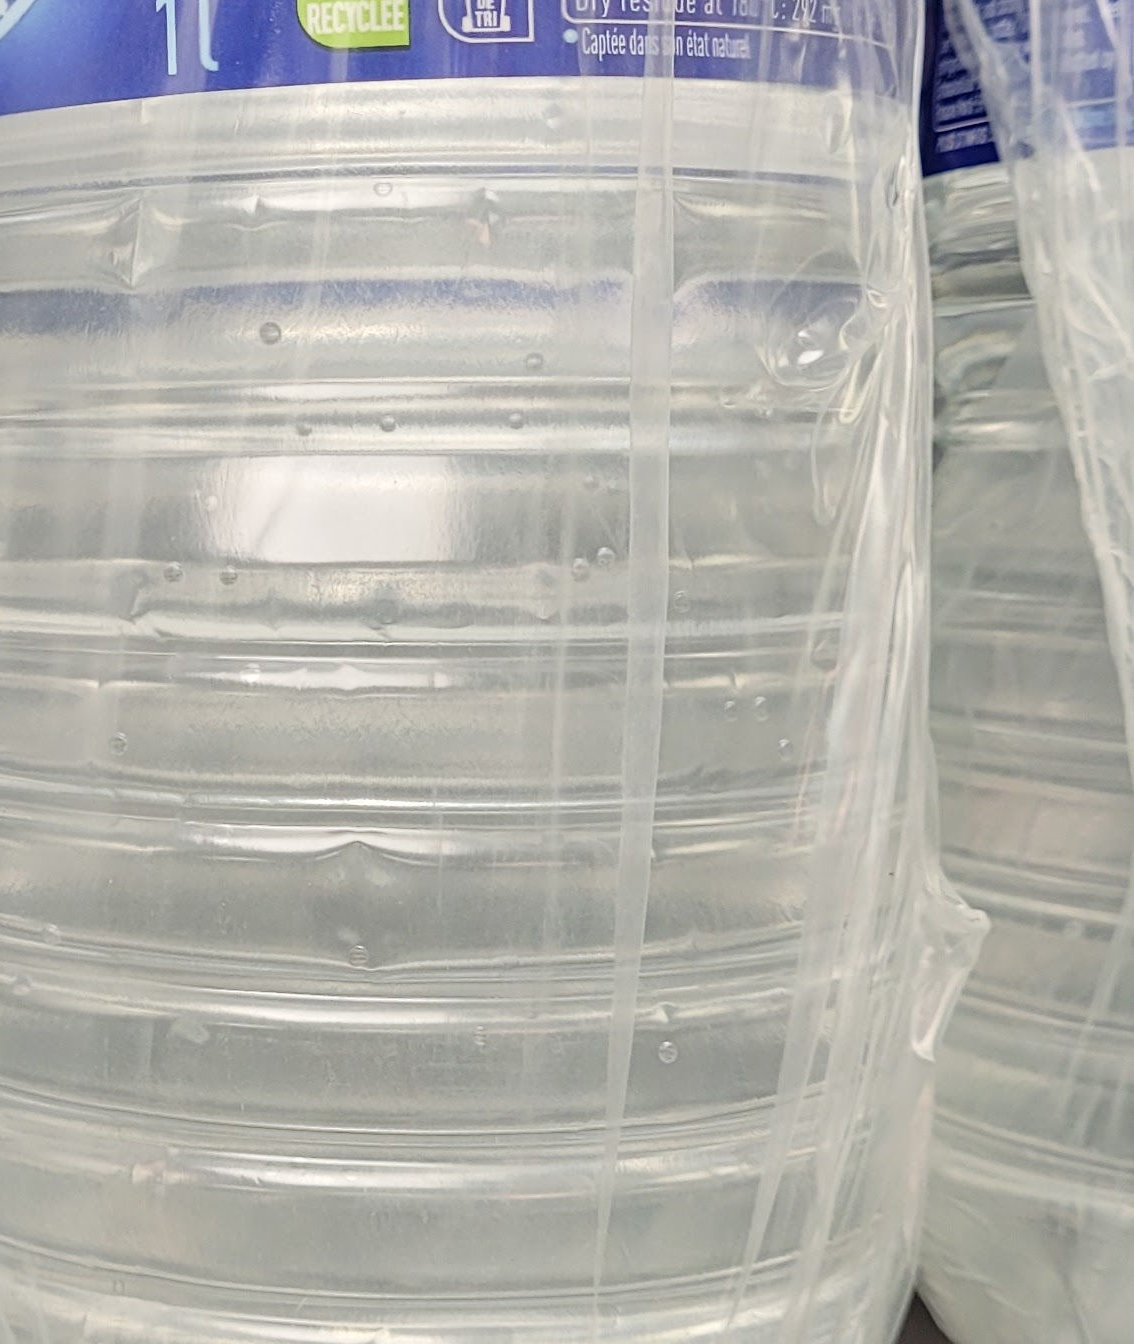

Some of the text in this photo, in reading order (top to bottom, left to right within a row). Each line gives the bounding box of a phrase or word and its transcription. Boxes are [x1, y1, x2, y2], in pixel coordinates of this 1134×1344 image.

[475, 11, 497, 28] TRI
[582, 27, 626, 62] Captée
[687, 29, 710, 58] état
